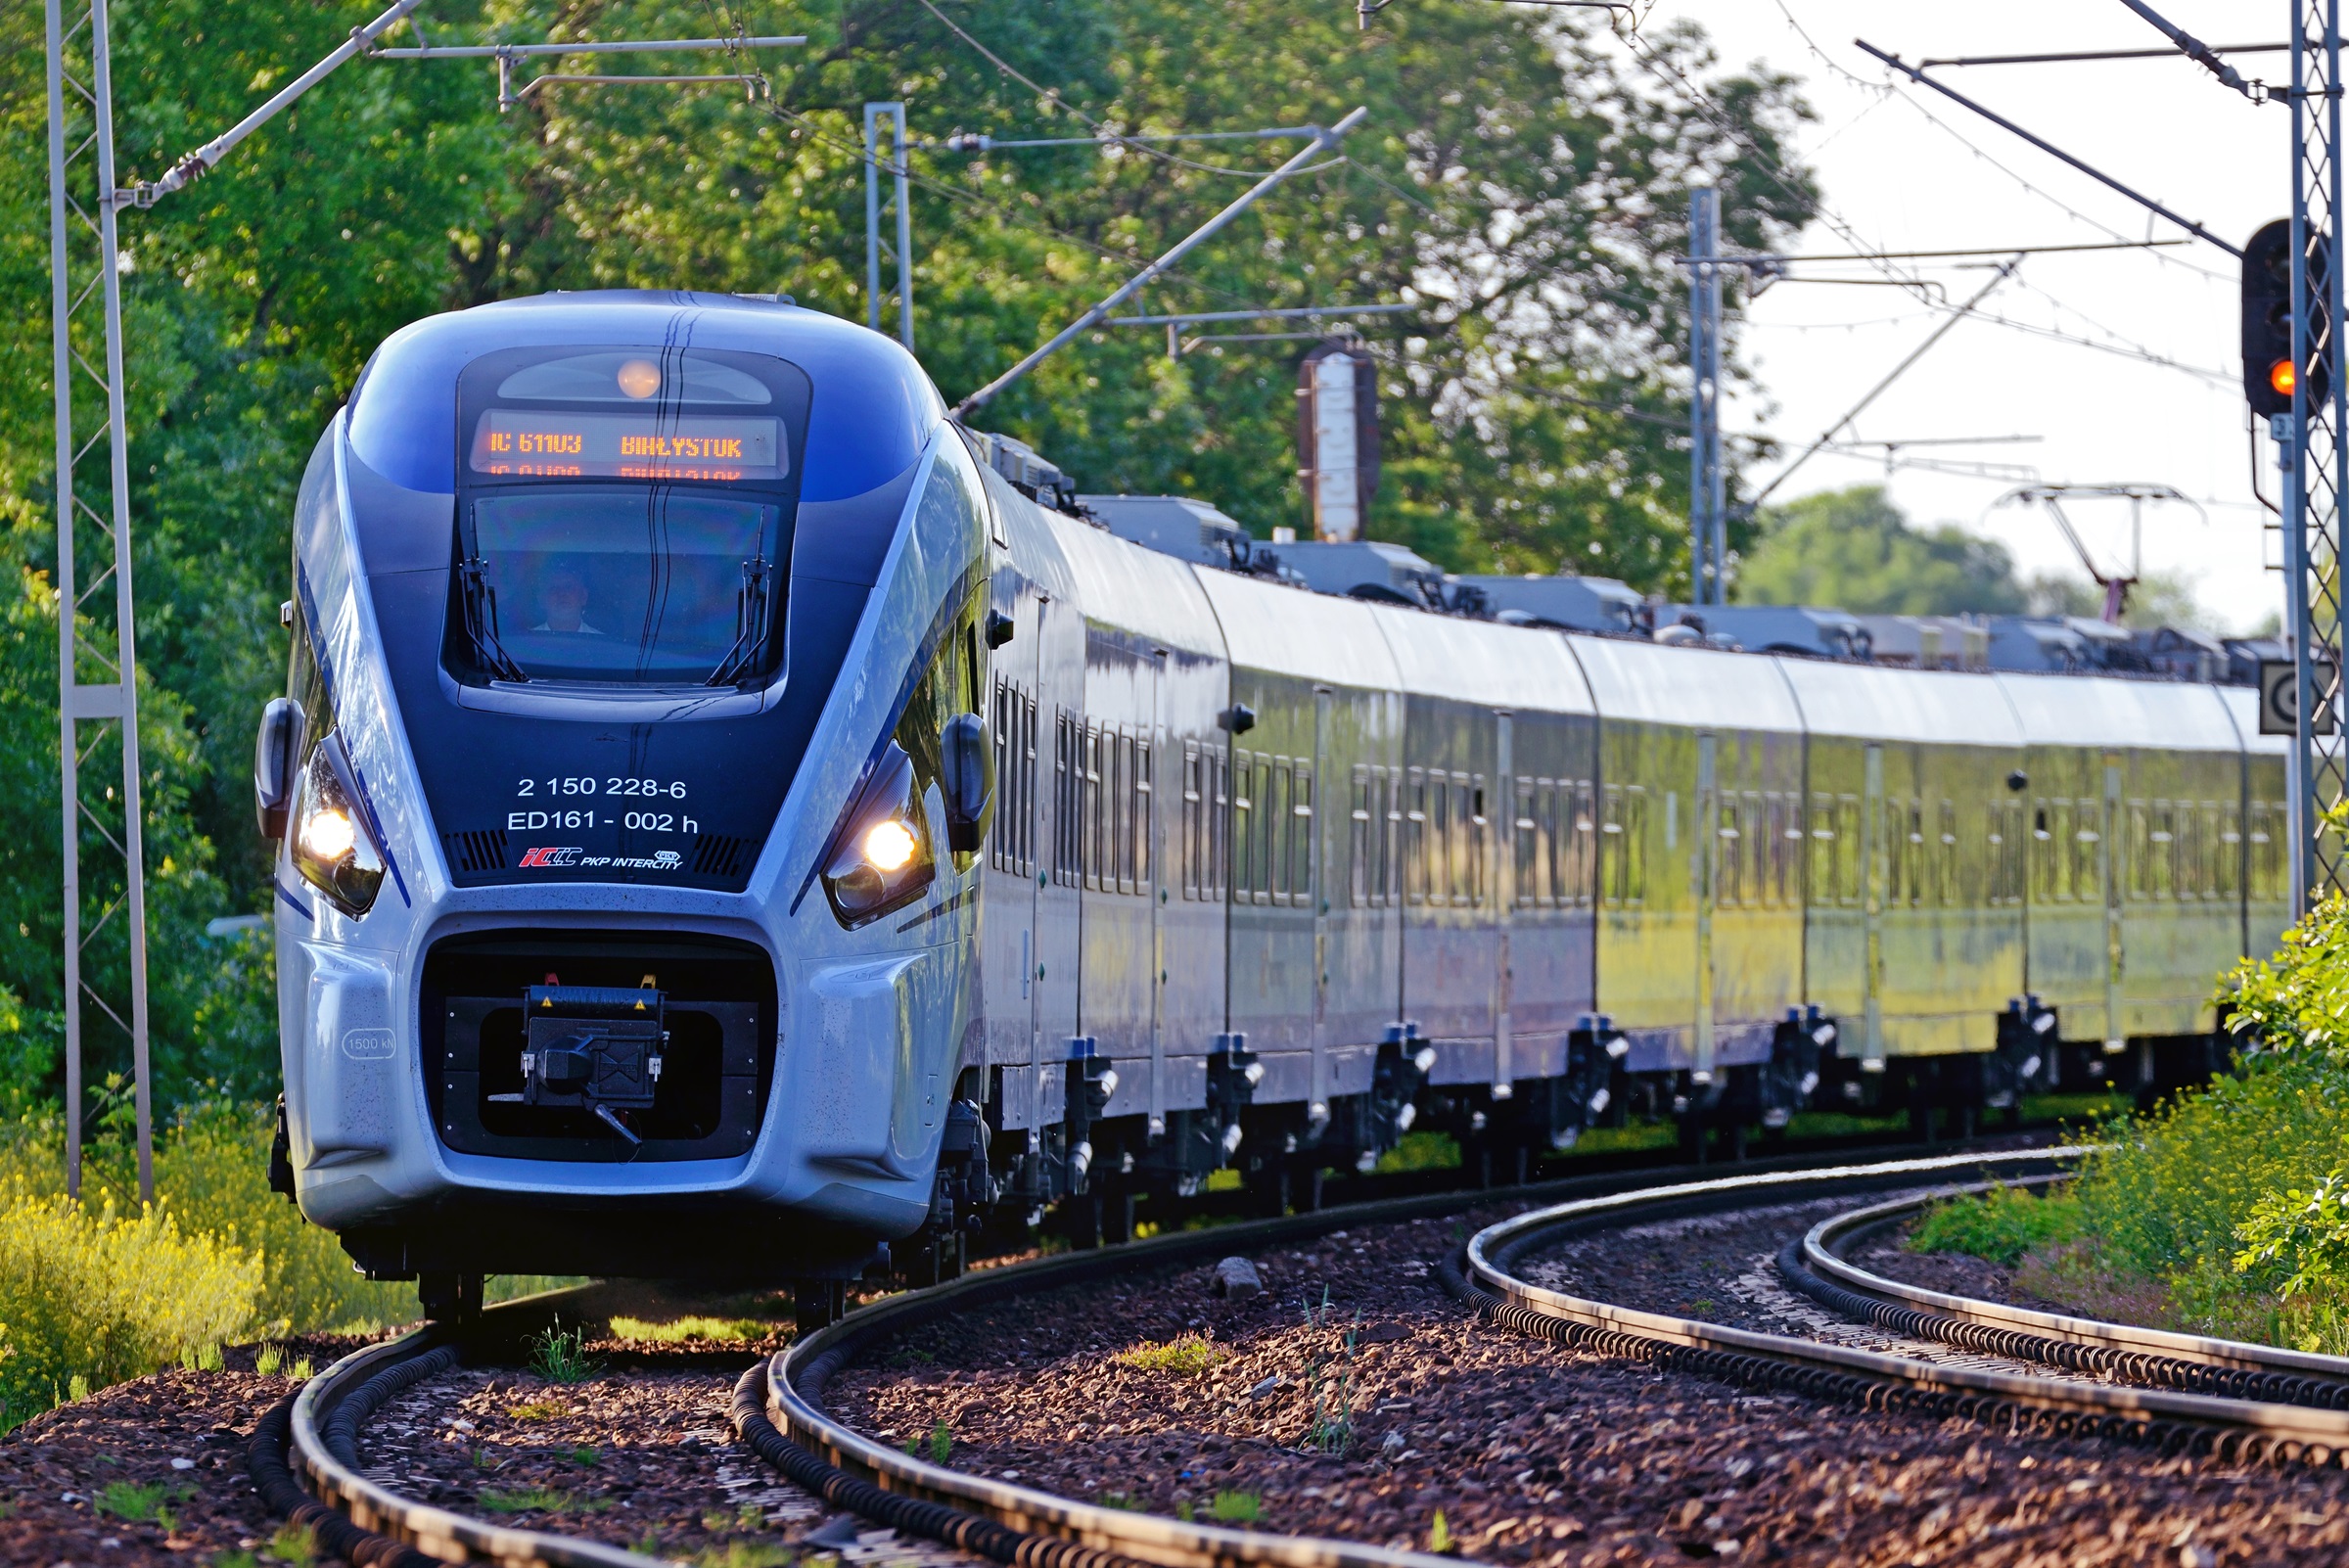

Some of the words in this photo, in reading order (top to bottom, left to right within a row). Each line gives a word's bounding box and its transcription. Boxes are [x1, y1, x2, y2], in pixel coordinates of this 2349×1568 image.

[490, 433, 511, 451] IC
[519, 434, 581, 453] 61103
[518, 778, 534, 797] 2
[546, 777, 596, 796] 150
[606, 777, 686, 799] 228-6
[507, 810, 594, 831] ED161
[624, 811, 673, 832] 002
[682, 815, 698, 834] h
[579, 856, 611, 866] PKP
[611, 857, 684, 870] INTERCITY
[348, 1038, 378, 1050] 1500
